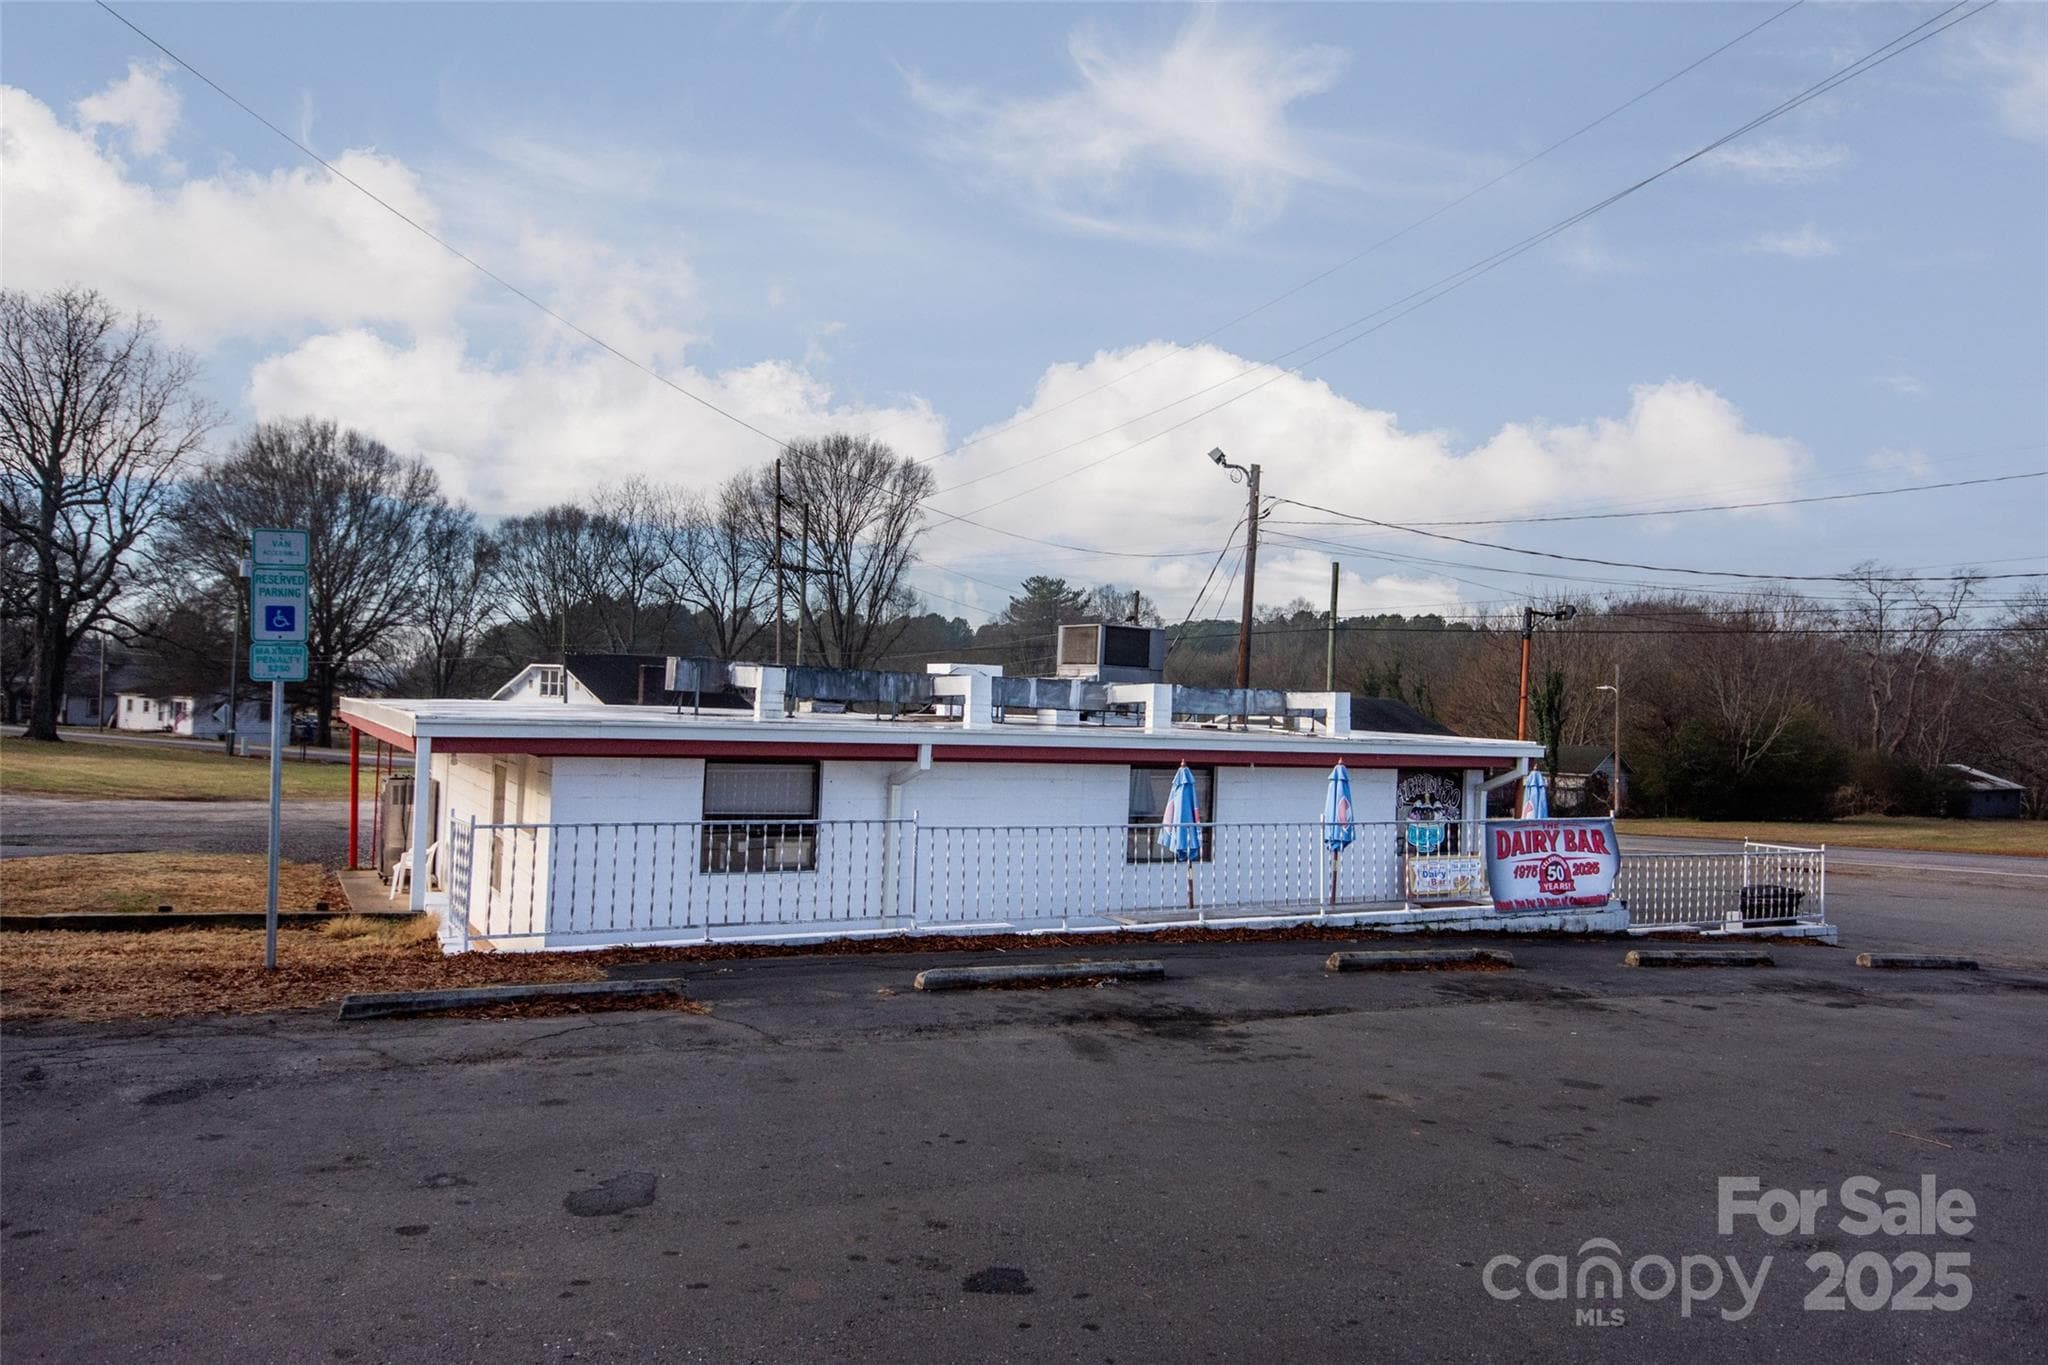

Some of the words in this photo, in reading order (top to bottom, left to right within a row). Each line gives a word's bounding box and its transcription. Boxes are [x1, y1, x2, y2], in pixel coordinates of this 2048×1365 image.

[271, 540, 292, 548] VAN
[255, 573, 305, 585] RESERVED
[258, 587, 301, 599] PARKING
[255, 655, 301, 664] PENALTY
[1495, 829, 1561, 860] DAIRY
[1563, 829, 1611, 856] BAR
[1547, 865, 1565, 882] 50
[1543, 881, 1571, 891] YEARS!
